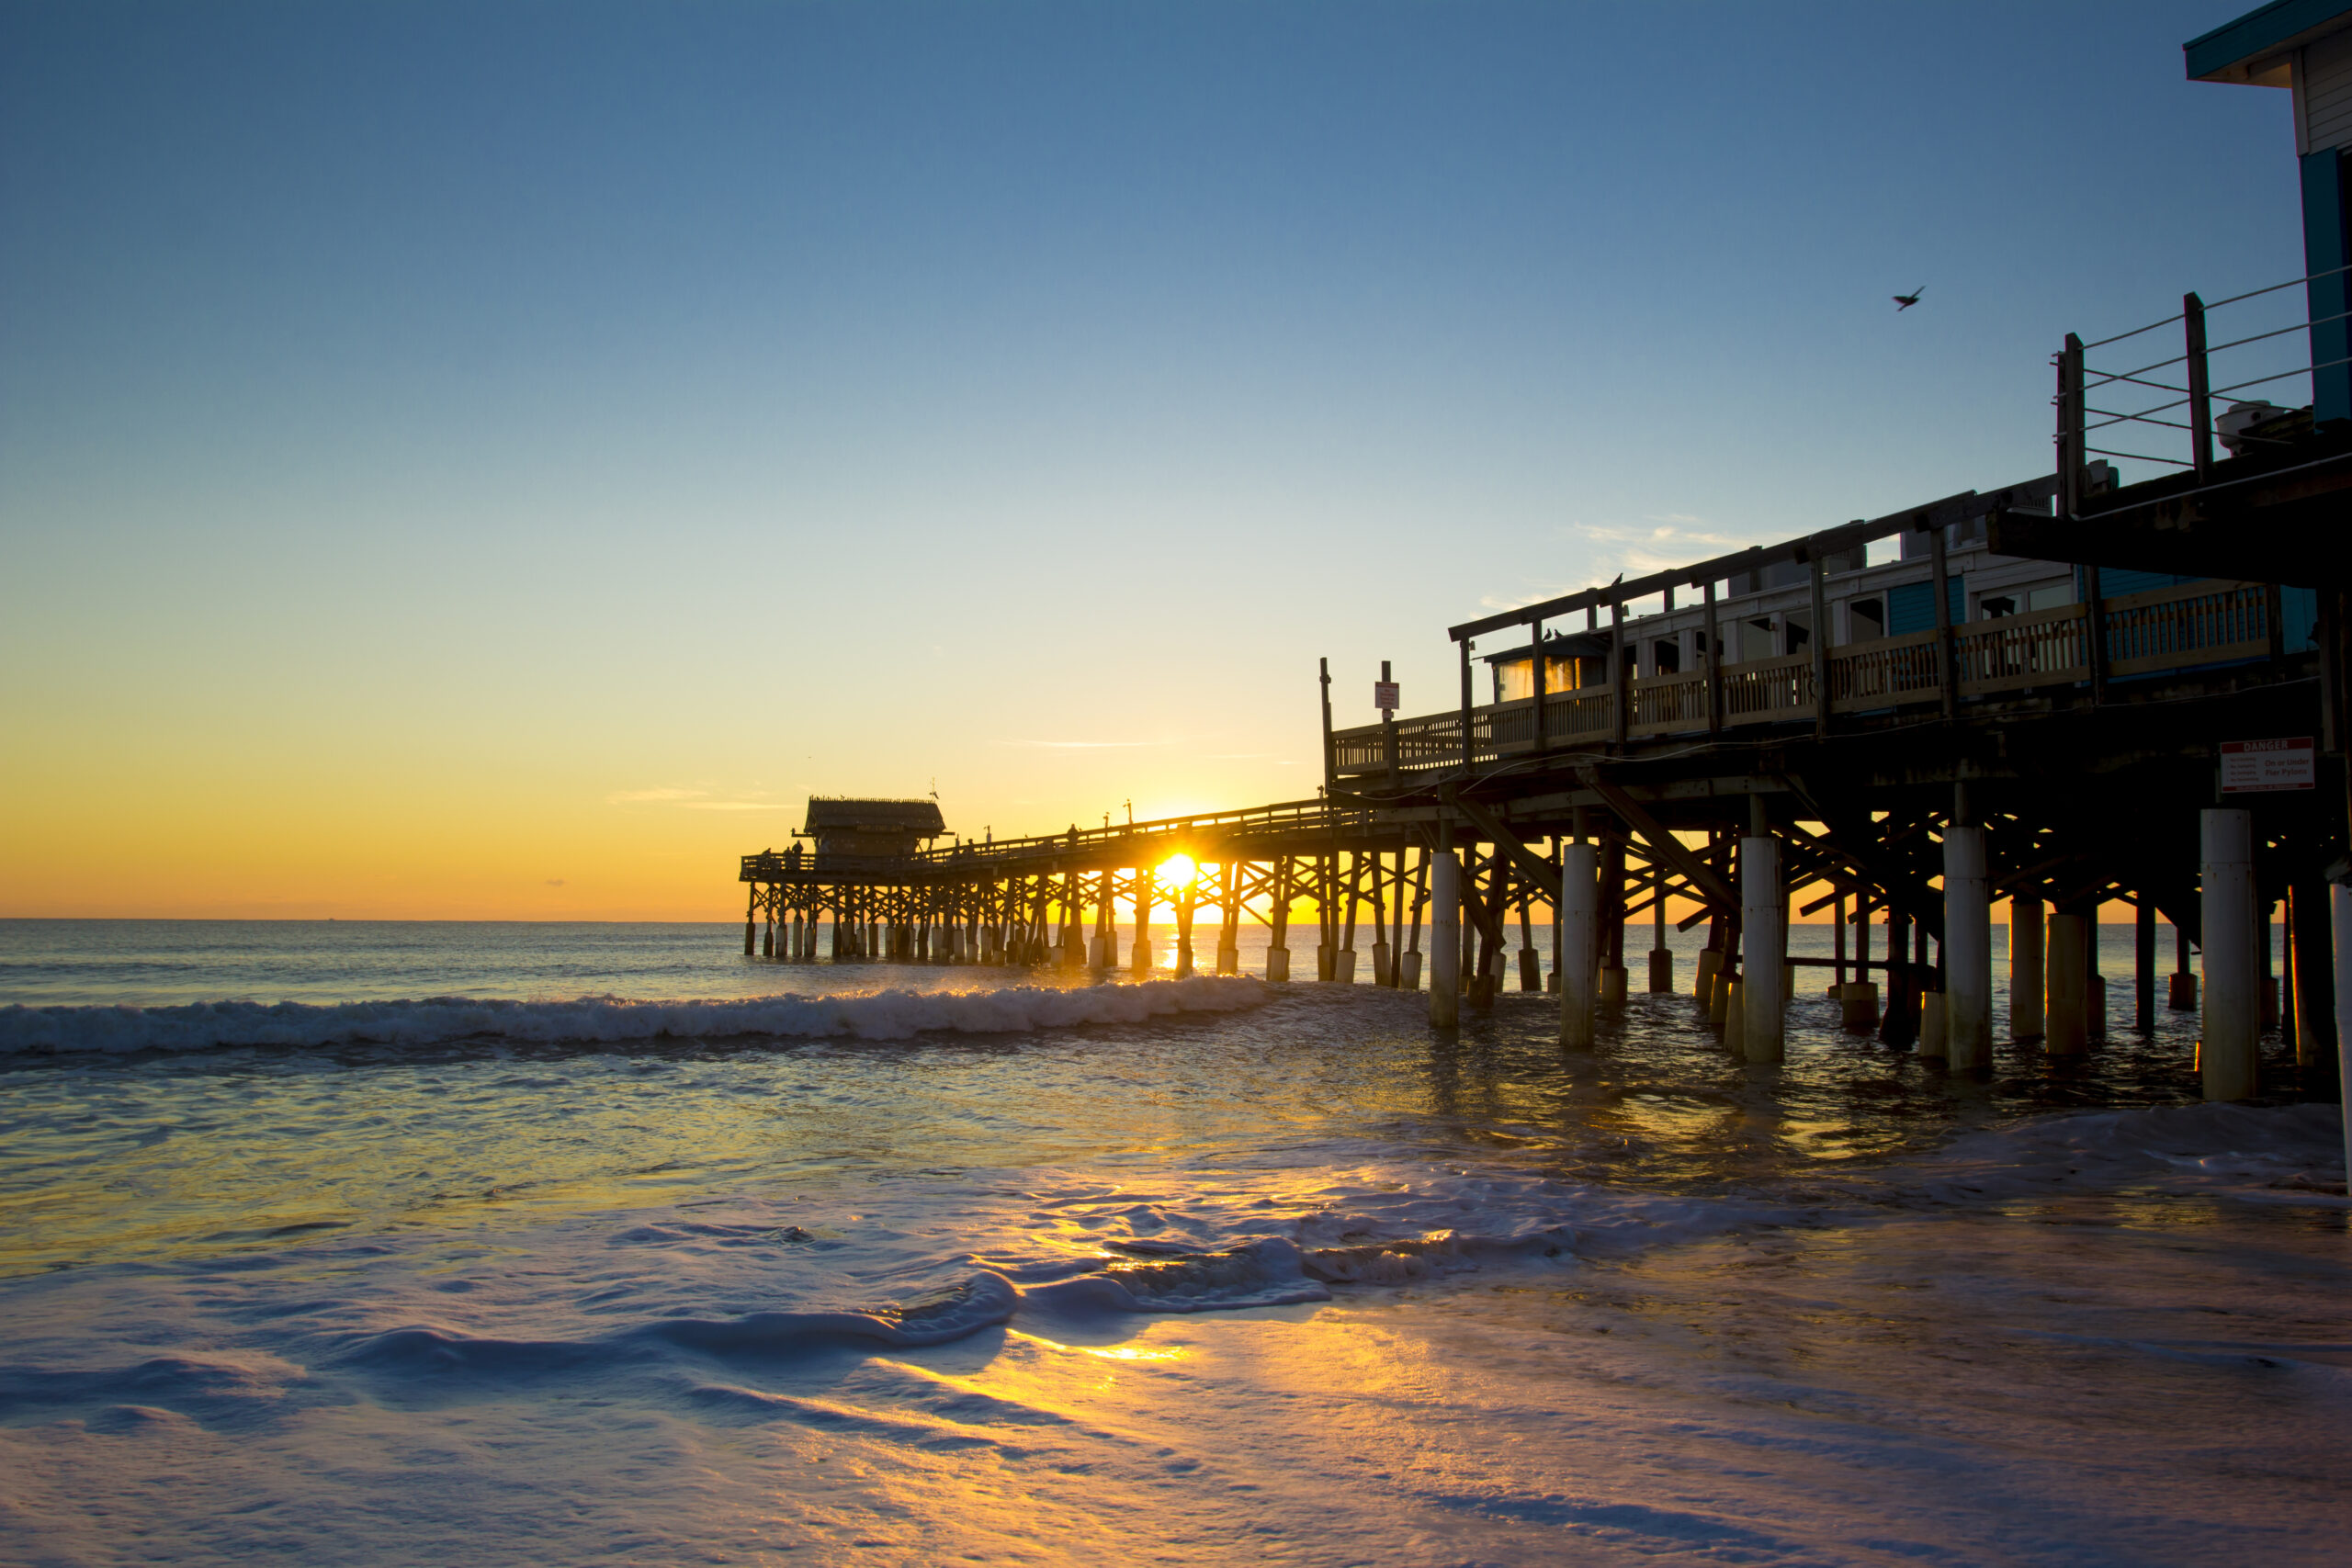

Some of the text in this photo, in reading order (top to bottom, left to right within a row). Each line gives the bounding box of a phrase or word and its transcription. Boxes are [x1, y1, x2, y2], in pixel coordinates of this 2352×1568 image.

[2244, 740, 2289, 751] DANGER
[2287, 758, 2309, 766] Under
[2281, 768, 2307, 777] Pylons
